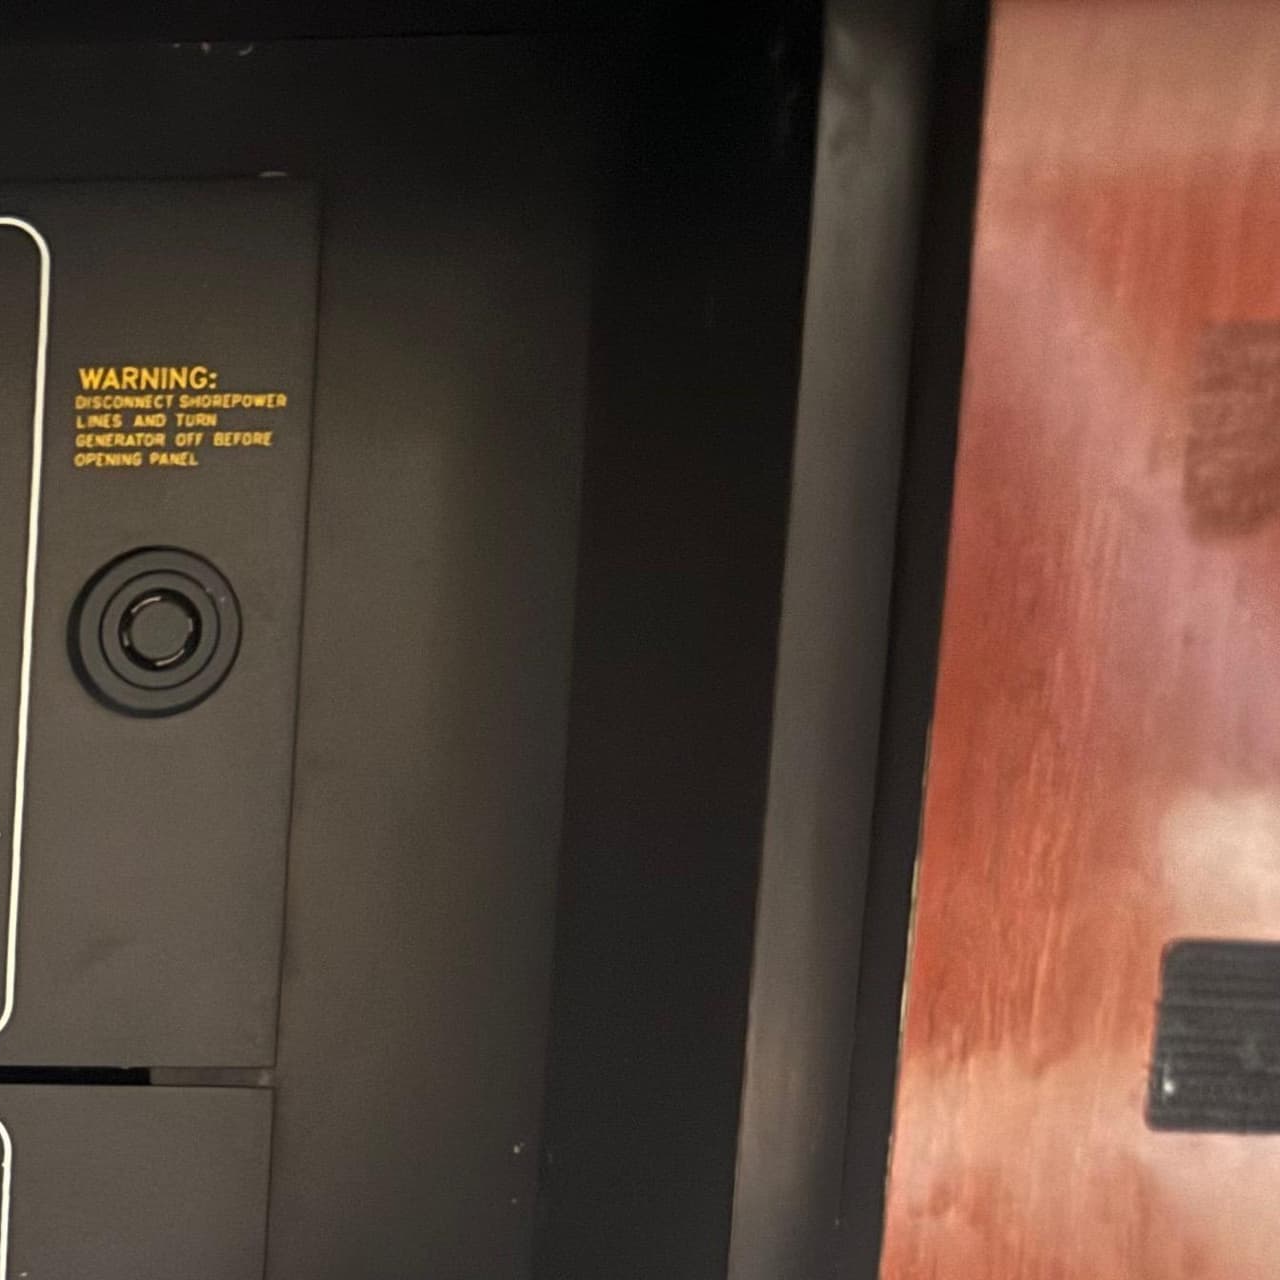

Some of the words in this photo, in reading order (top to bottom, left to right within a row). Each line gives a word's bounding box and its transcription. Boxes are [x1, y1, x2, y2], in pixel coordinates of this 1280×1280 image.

[80, 366, 216, 390] WARNING:
[76, 395, 173, 409] DISCONNECT
[179, 394, 287, 408] SHOREPOWER
[76, 414, 122, 429] LINES
[134, 413, 166, 427] AND
[176, 413, 217, 427] TURN
[76, 433, 165, 448] GENERATOR
[175, 432, 203, 447] OFF
[214, 432, 272, 446] BEFORE
[74, 452, 142, 467] OPENING
[150, 452, 198, 466] PANEL
